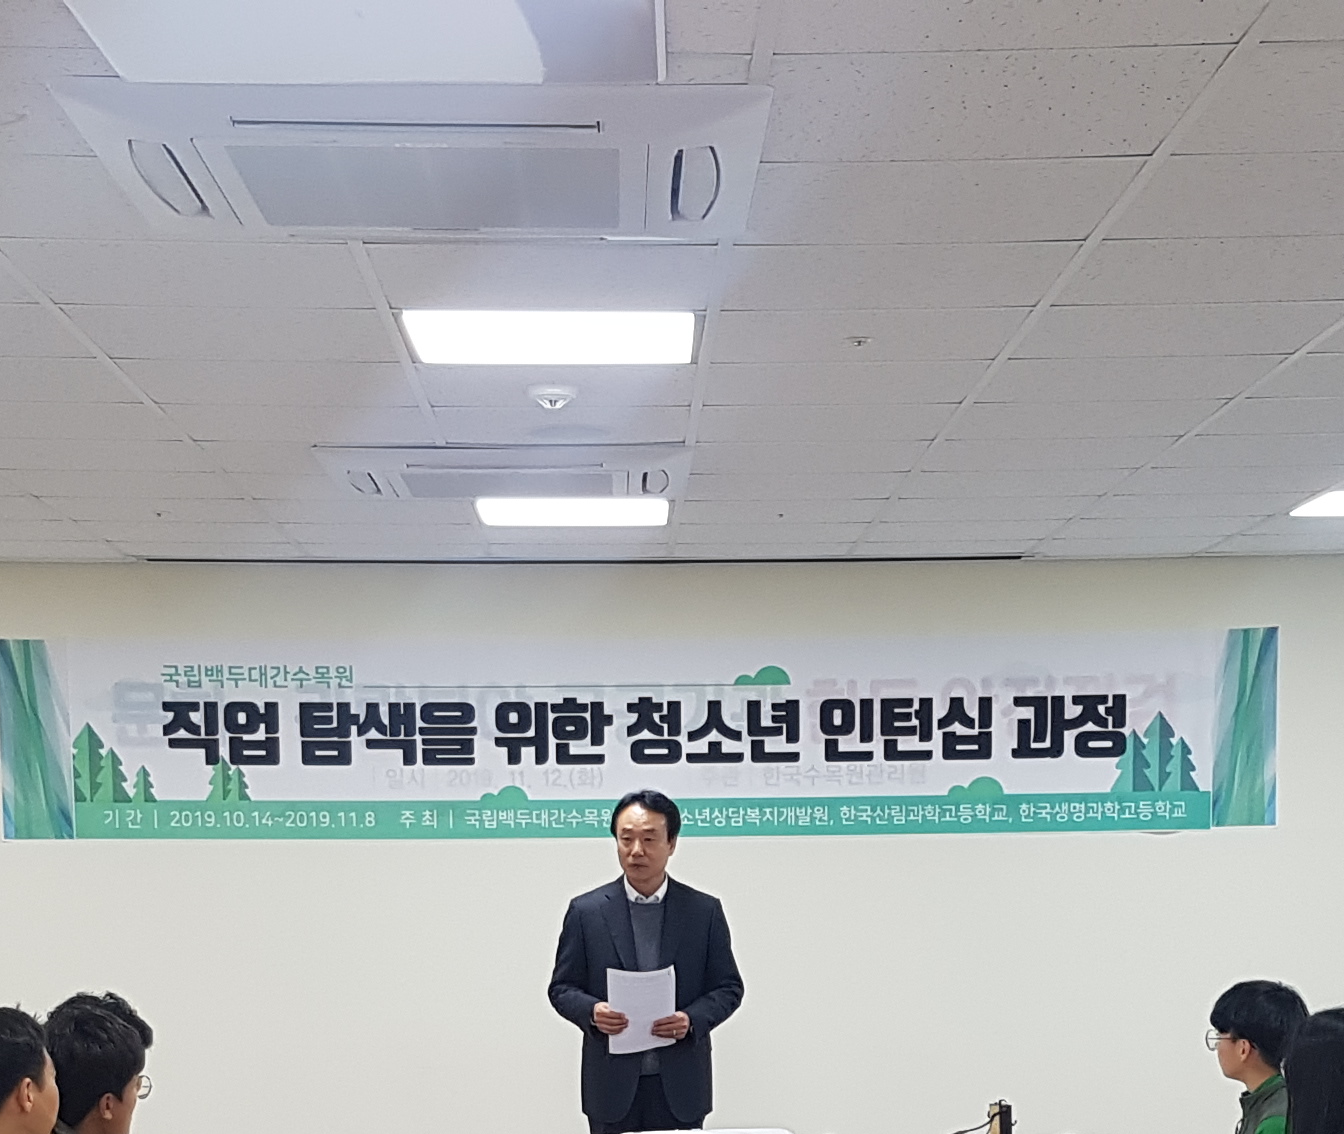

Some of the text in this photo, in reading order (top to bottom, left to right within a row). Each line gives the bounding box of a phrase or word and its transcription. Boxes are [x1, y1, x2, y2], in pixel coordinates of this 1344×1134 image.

[160, 664, 355, 689] 국립백두대간수목원
[161, 701, 280, 766] 직업
[298, 701, 478, 766] 탐색을
[494, 697, 614, 766] 위한
[626, 696, 801, 765] 청소년
[819, 696, 993, 763] 인턴십
[1011, 693, 1128, 760] 과정
[170, 811, 376, 828] 2019.10.14~2019.11.8
[681, 805, 834, 827] 소년상담복지개발원,
[840, 803, 1013, 825] 한국산림과학고등학교,
[1019, 801, 1187, 822] 한국생명과학고등학교
